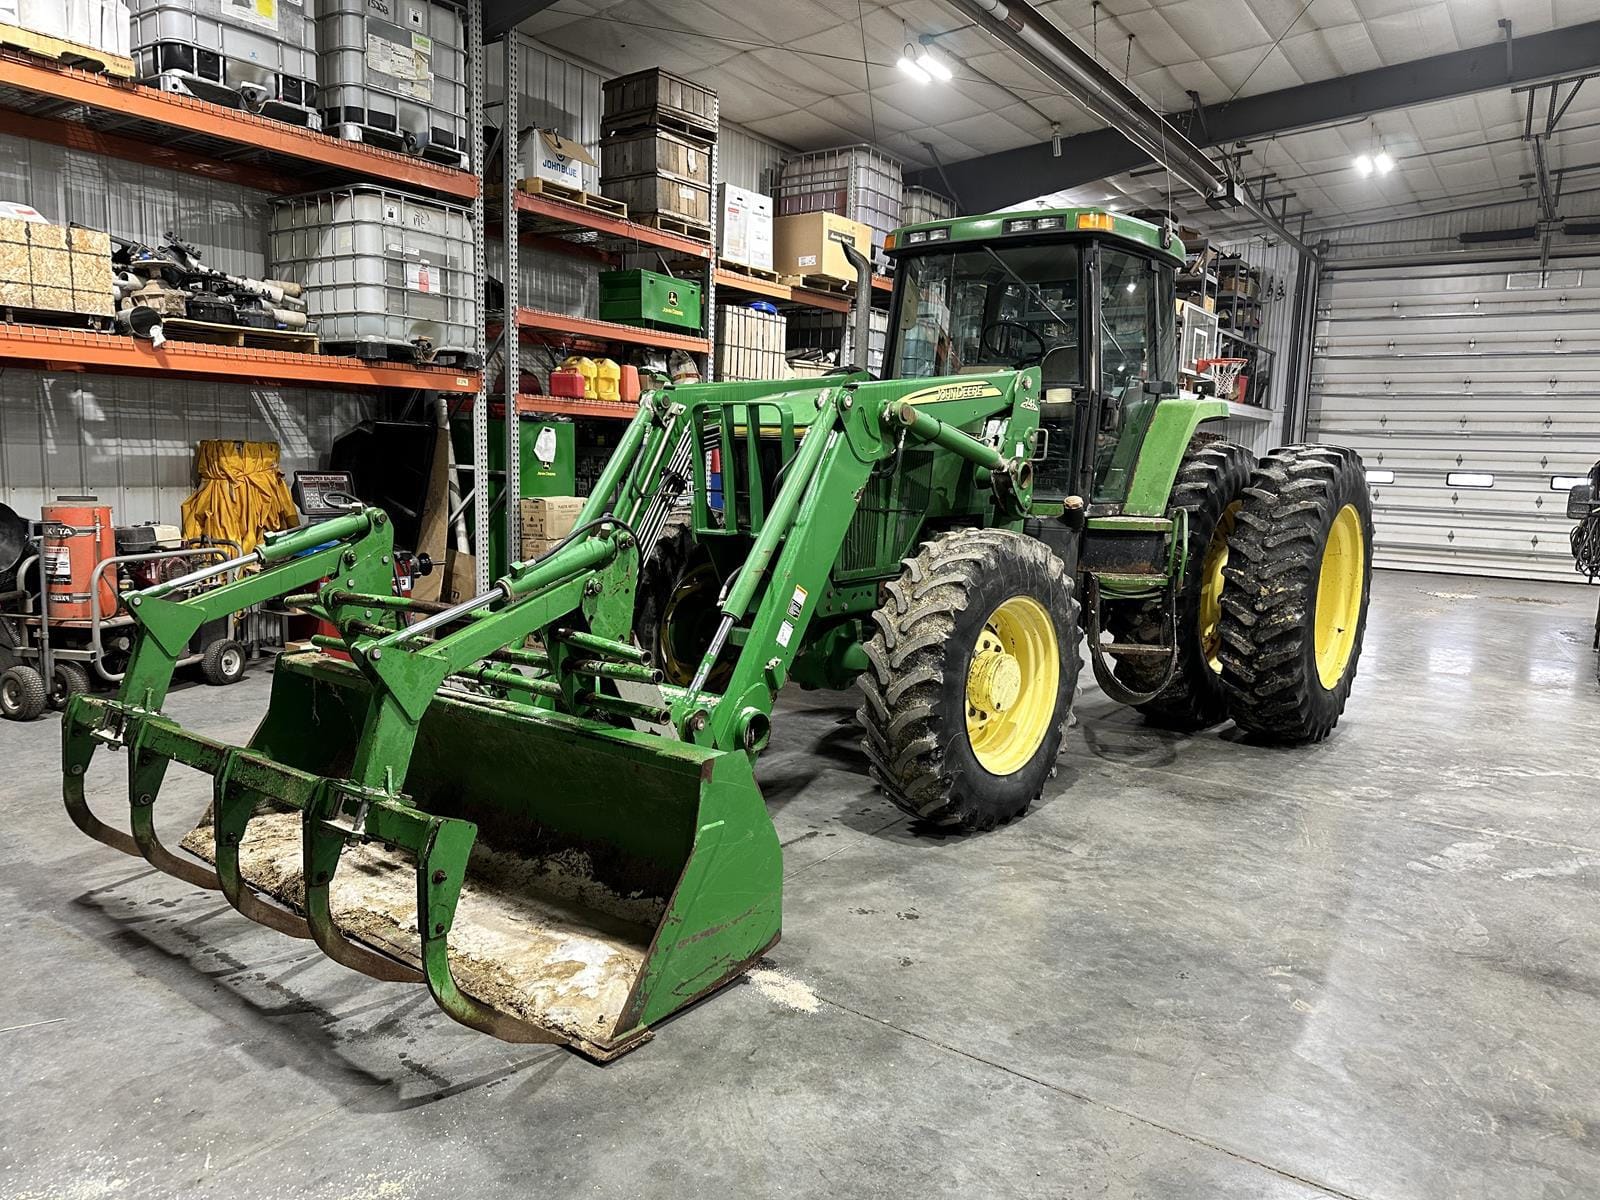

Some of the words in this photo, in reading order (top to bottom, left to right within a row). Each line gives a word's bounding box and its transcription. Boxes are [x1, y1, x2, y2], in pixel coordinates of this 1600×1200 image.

[543, 159, 561, 173] JOHN
[561, 165, 577, 178] BLUE
[936, 387, 957, 400] JOHN
[957, 385, 983, 398] DEERE
